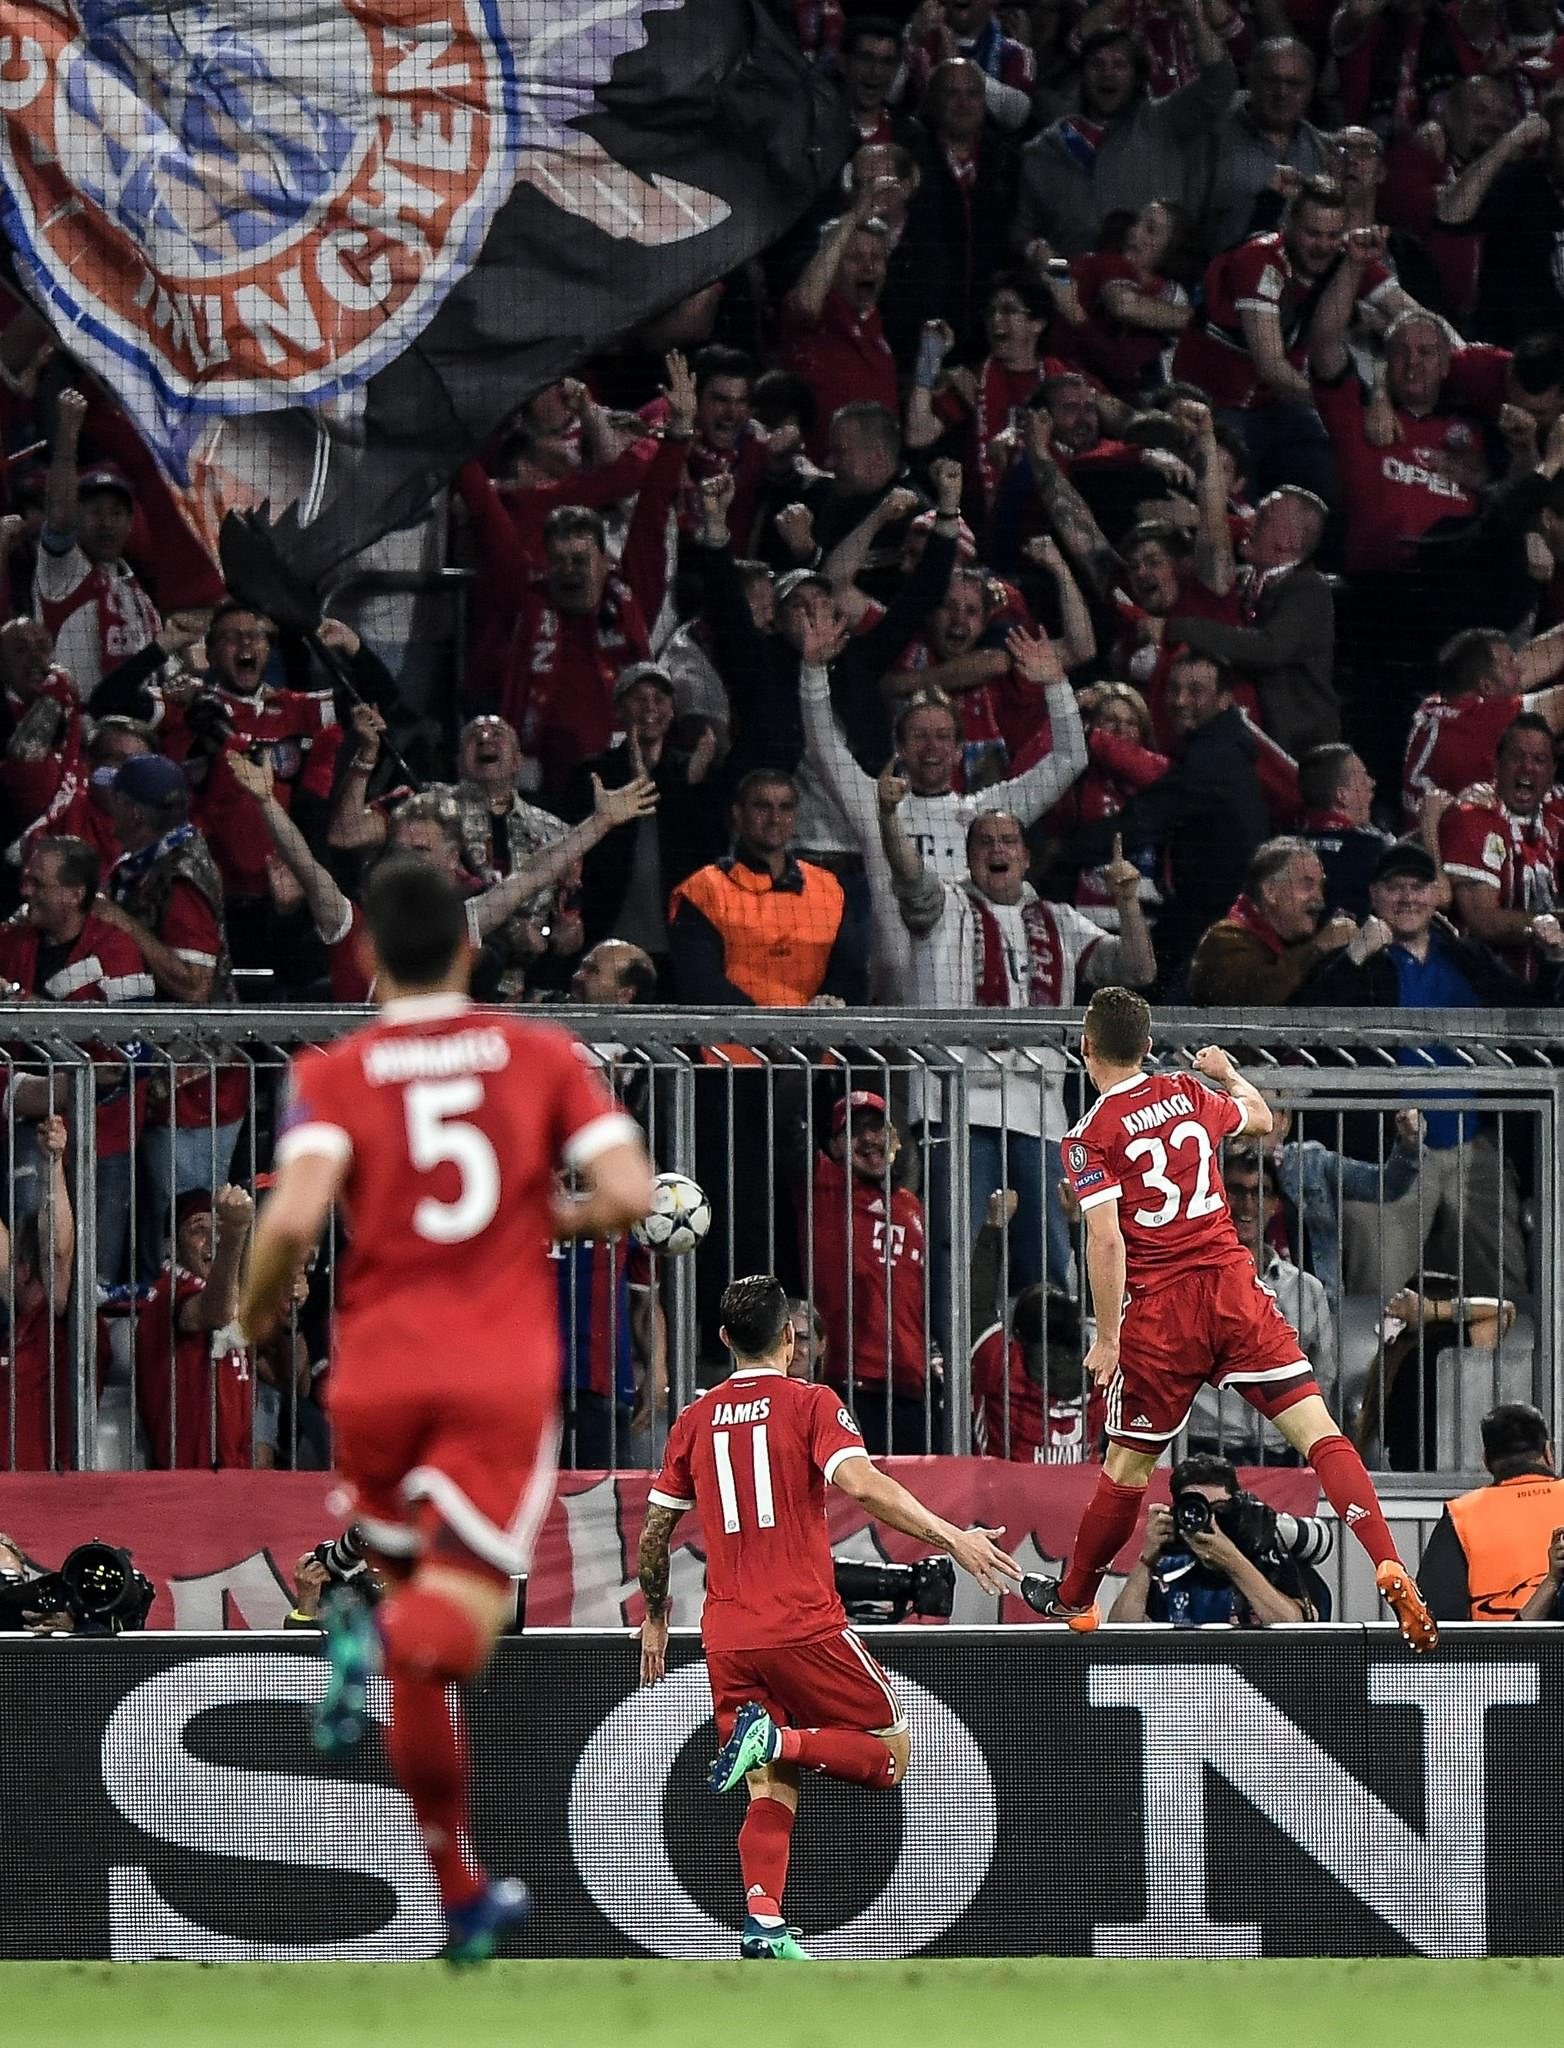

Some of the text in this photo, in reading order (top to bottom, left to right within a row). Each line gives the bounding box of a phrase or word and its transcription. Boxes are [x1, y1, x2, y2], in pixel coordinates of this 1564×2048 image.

[403, 1074, 502, 1247] 5
[1124, 1119, 1225, 1228] 32
[711, 1396, 772, 1428] JAMES
[712, 1423, 777, 1536] 11
